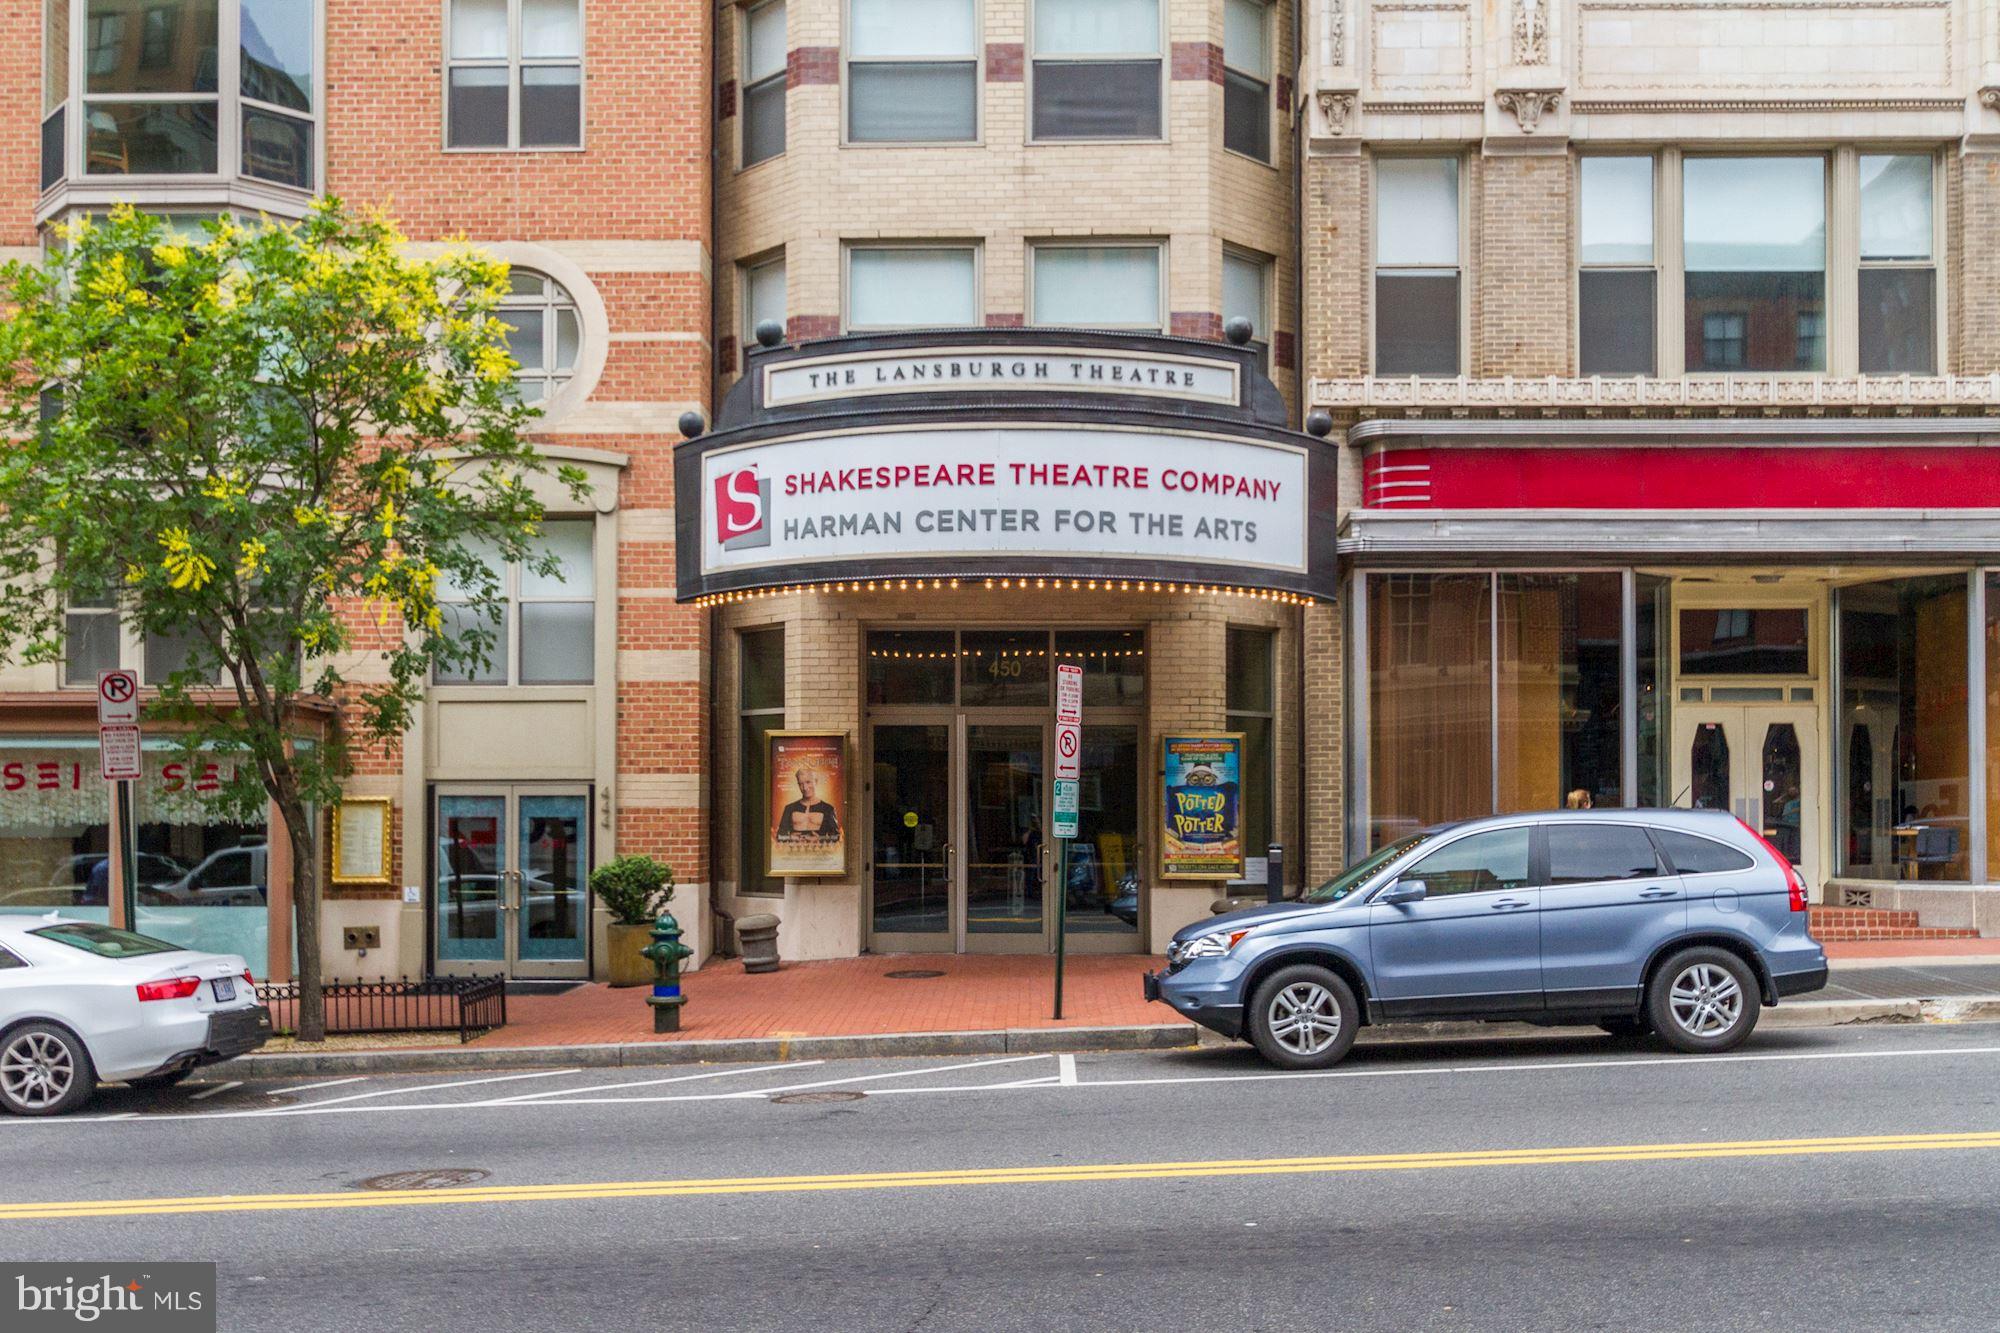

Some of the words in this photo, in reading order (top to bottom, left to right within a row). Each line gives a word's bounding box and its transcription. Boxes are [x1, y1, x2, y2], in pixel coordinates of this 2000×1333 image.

[809, 370, 855, 388] THE
[876, 362, 1048, 383] LANSBURGH
[1070, 363, 1195, 387] THEATRE
[784, 463, 995, 496] SHAKESPEARE
[1009, 463, 1149, 489] THEATRE
[1161, 468, 1281, 502] COMPANY
[783, 511, 902, 542] HARMAN
[915, 508, 1041, 534] CENTER
[1054, 509, 1118, 535] FOR
[1128, 511, 1184, 538] THE
[1193, 516, 1258, 544] ARTS
[988, 660, 1021, 677] 450
[3, 762, 80, 791] SEI
[1174, 792, 1226, 814] POTTED
[1173, 812, 1225, 838] POTTER
